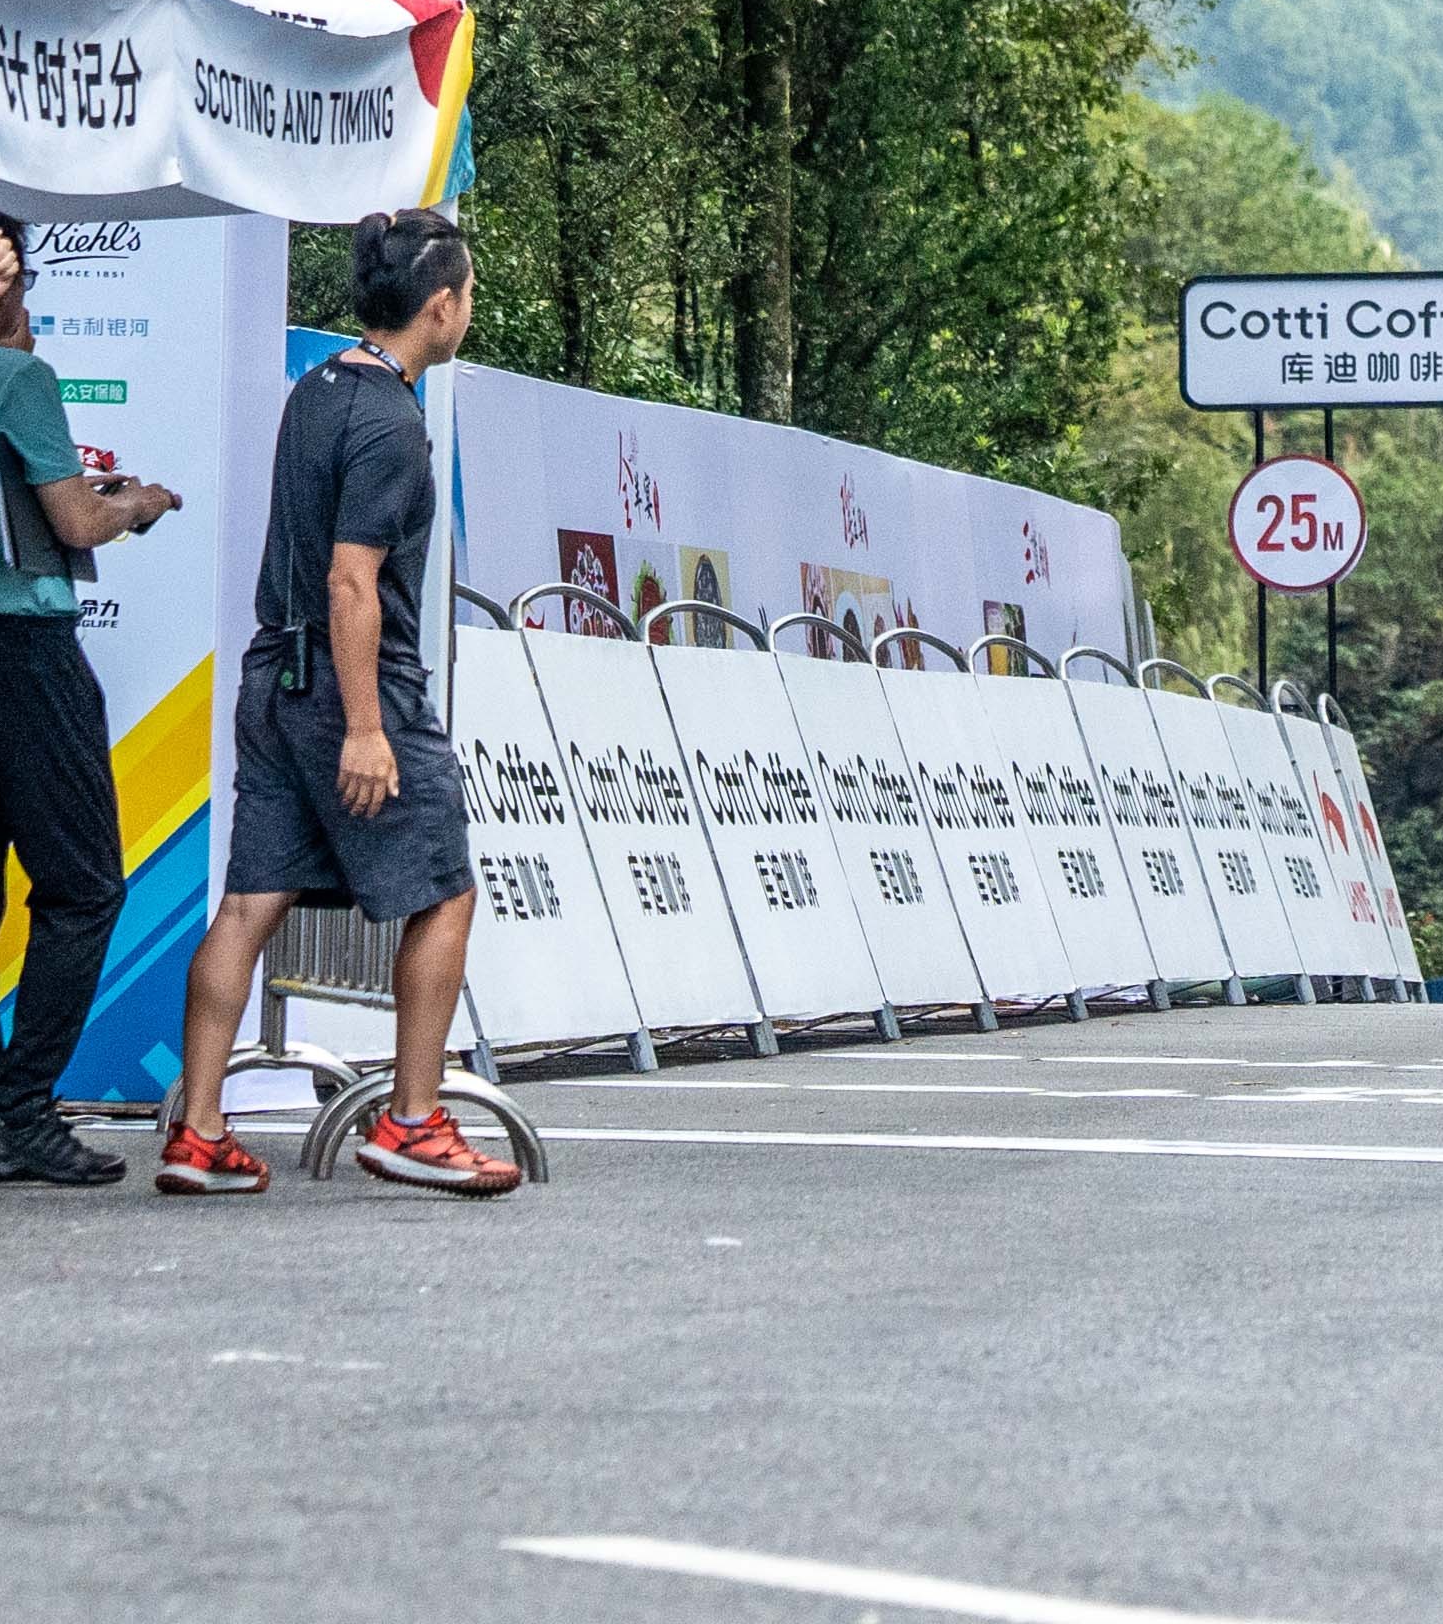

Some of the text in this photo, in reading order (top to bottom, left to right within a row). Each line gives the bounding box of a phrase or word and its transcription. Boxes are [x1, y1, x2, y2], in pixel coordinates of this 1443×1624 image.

[194, 58, 394, 146] SCOTING AND TIMING
[51, 269, 125, 279] SINCE 1851
[62, 317, 150, 338] 吉利银河
[1199, 300, 1328, 340] Cotti
[62, 382, 127, 402] 众安保险
[1281, 351, 1443, 385] 库迪咖啡
[1256, 493, 1344, 552] 25M
[475, 738, 565, 826] Coffee
[569, 740, 631, 826] Cotti
[617, 744, 690, 826] Coffee
[744, 749, 817, 826] Coffee
